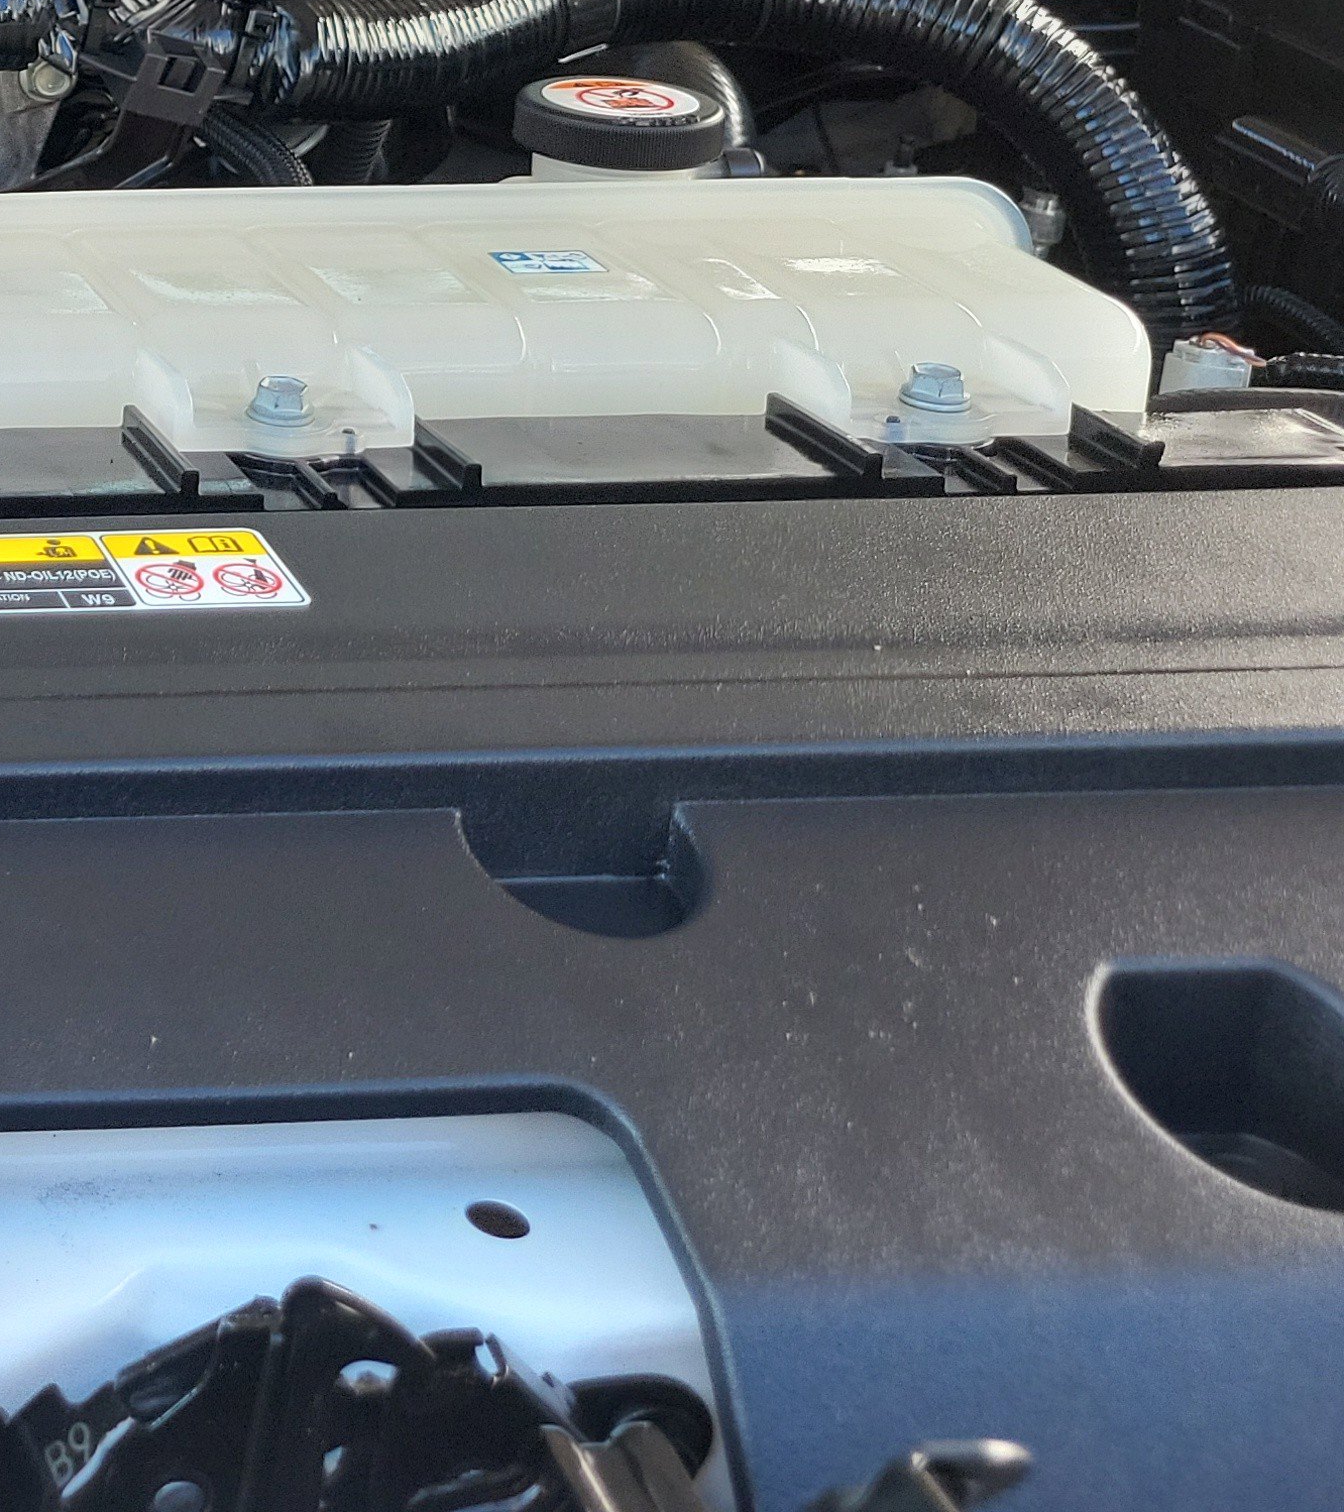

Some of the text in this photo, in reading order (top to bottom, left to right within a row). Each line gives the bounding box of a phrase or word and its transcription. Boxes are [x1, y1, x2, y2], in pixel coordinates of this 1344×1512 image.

[3, 569, 116, 583] ND-OIL12(POE)
[81, 594, 116, 606] W9
[45, 1422, 90, 1488] B9
